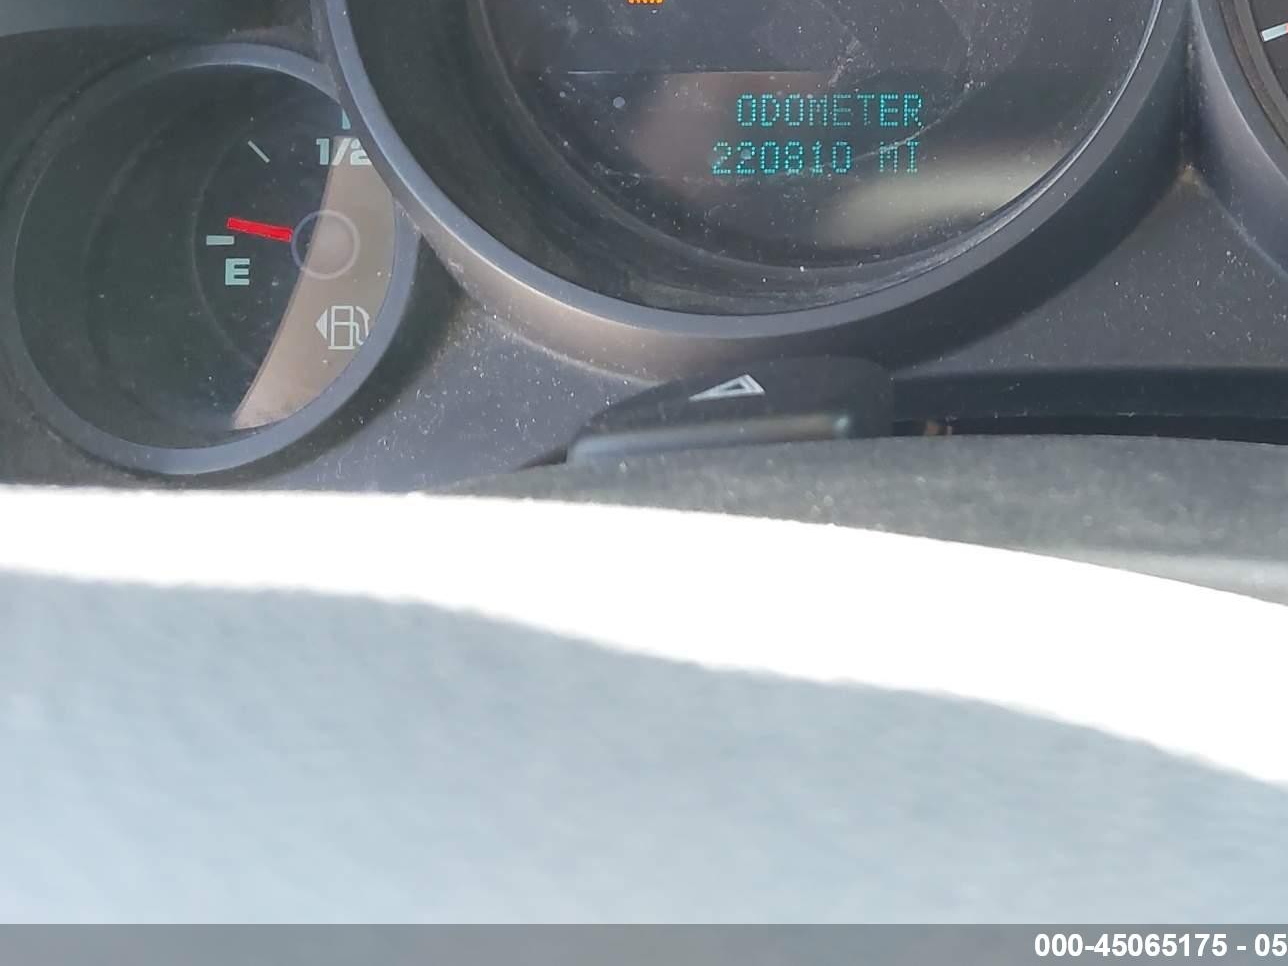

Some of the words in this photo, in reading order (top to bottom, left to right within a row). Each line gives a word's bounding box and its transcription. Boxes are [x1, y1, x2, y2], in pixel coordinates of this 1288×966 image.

[737, 94, 924, 126] ODOMETER
[316, 137, 372, 166] 1/2
[712, 141, 852, 175] 220810
[879, 141, 920, 174] MI
[225, 258, 250, 285] E
